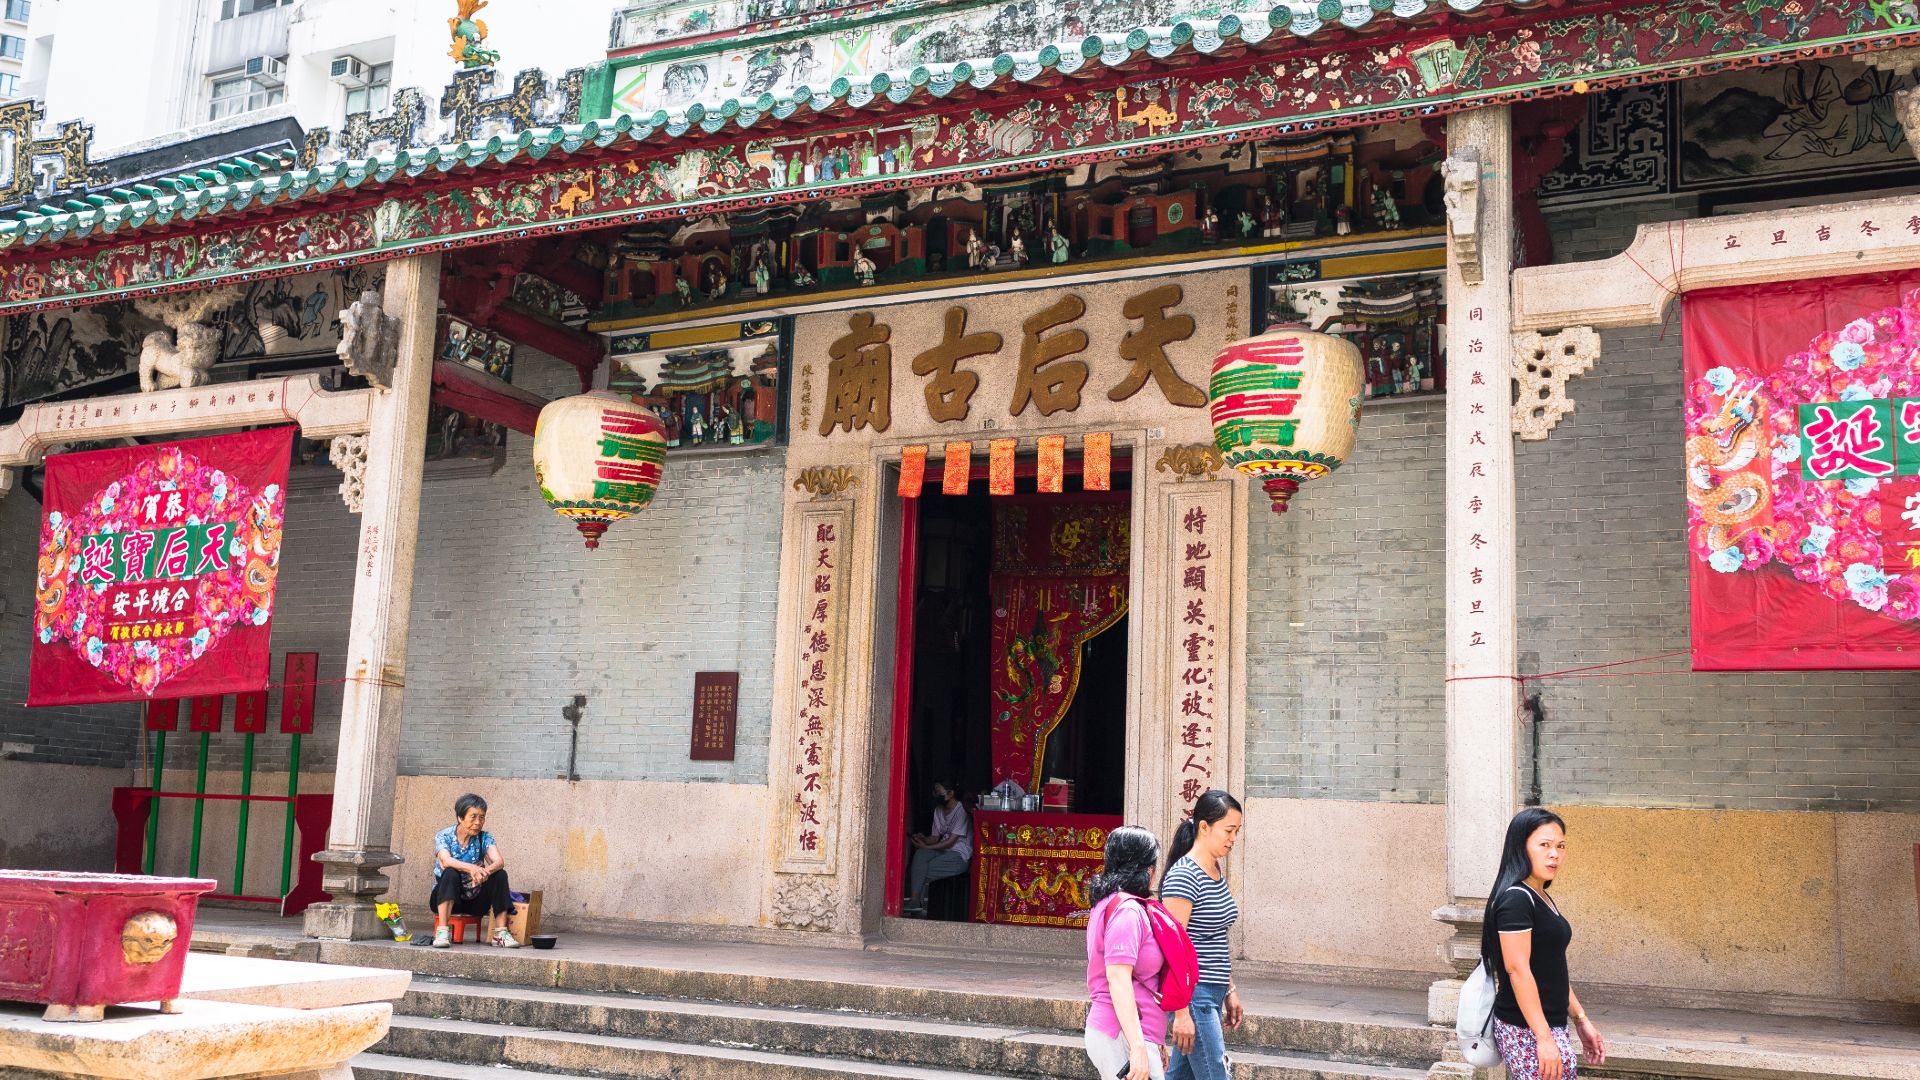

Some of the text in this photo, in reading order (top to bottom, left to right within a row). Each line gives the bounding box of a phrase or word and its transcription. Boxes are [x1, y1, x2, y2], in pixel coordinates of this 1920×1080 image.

[819, 283, 1207, 437] 天后古廟
[1804, 401, 1920, 480] 誕
[139, 492, 186, 523] 恭賀
[80, 523, 231, 584] 天后寶誕
[112, 586, 190, 616] 合境平安
